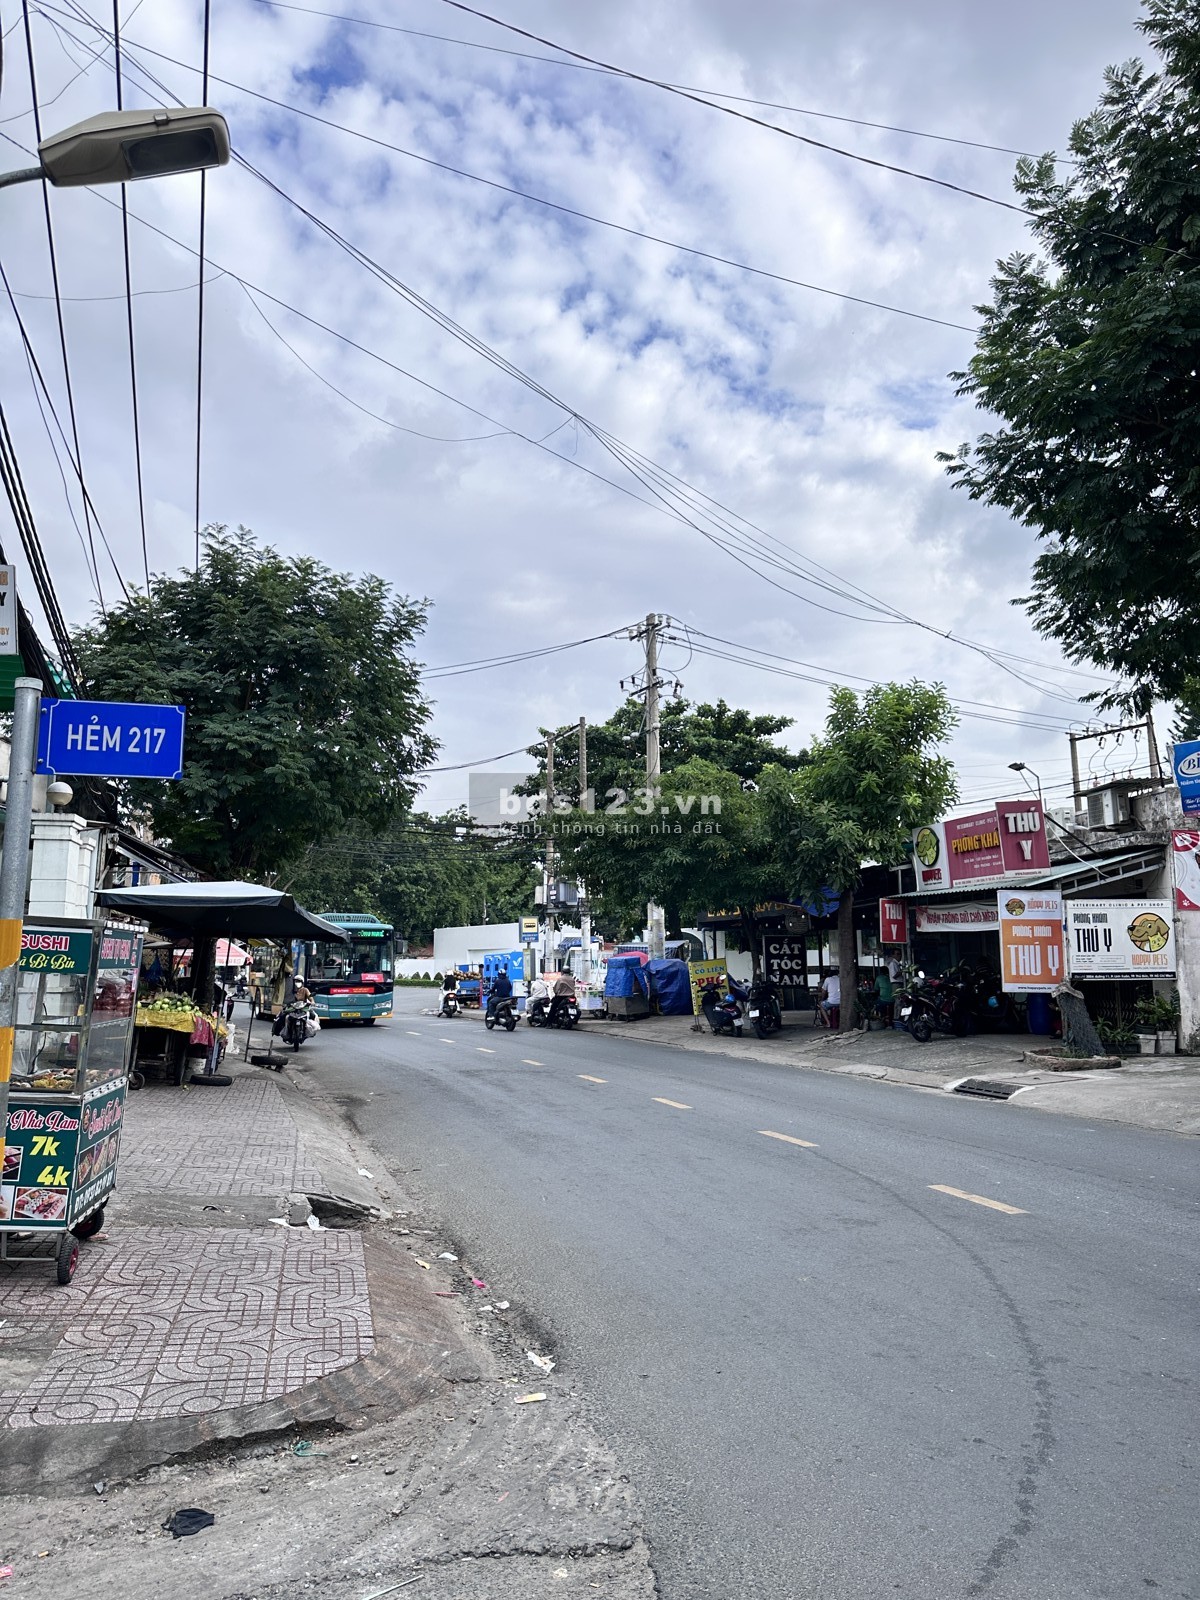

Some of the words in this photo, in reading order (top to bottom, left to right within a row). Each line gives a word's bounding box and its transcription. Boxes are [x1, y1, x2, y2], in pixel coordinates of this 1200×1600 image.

[66, 715, 122, 752] HẺM
[127, 727, 166, 754] 217
[1004, 807, 1041, 833] THÚ
[952, 834, 980, 853] PHÒNG
[981, 829, 1000, 848] KHÁ
[1020, 840, 1033, 860] Y
[885, 901, 903, 920] THÚ
[891, 924, 897, 940] Y
[1012, 925, 1032, 938] PHÒNG
[1033, 925, 1052, 937] KHÁM
[1074, 925, 1100, 952] THÚ
[1103, 928, 1112, 952] Y
[21, 933, 70, 951] SUSHI
[769, 939, 801, 955] CẮT
[29, 952, 50, 969] Bi
[50, 953, 75, 969] Bin
[770, 956, 802, 970] TÓC
[1007, 941, 1042, 976] THÚ
[1047, 945, 1059, 977] Y
[1131, 953, 1152, 966] HAPPY
[1153, 953, 1168, 966] PETS
[10, 1110, 45, 1130] Nhà
[45, 1111, 78, 1132] Làm
[29, 1135, 61, 1156] 7k
[36, 1165, 71, 1186] 4k
